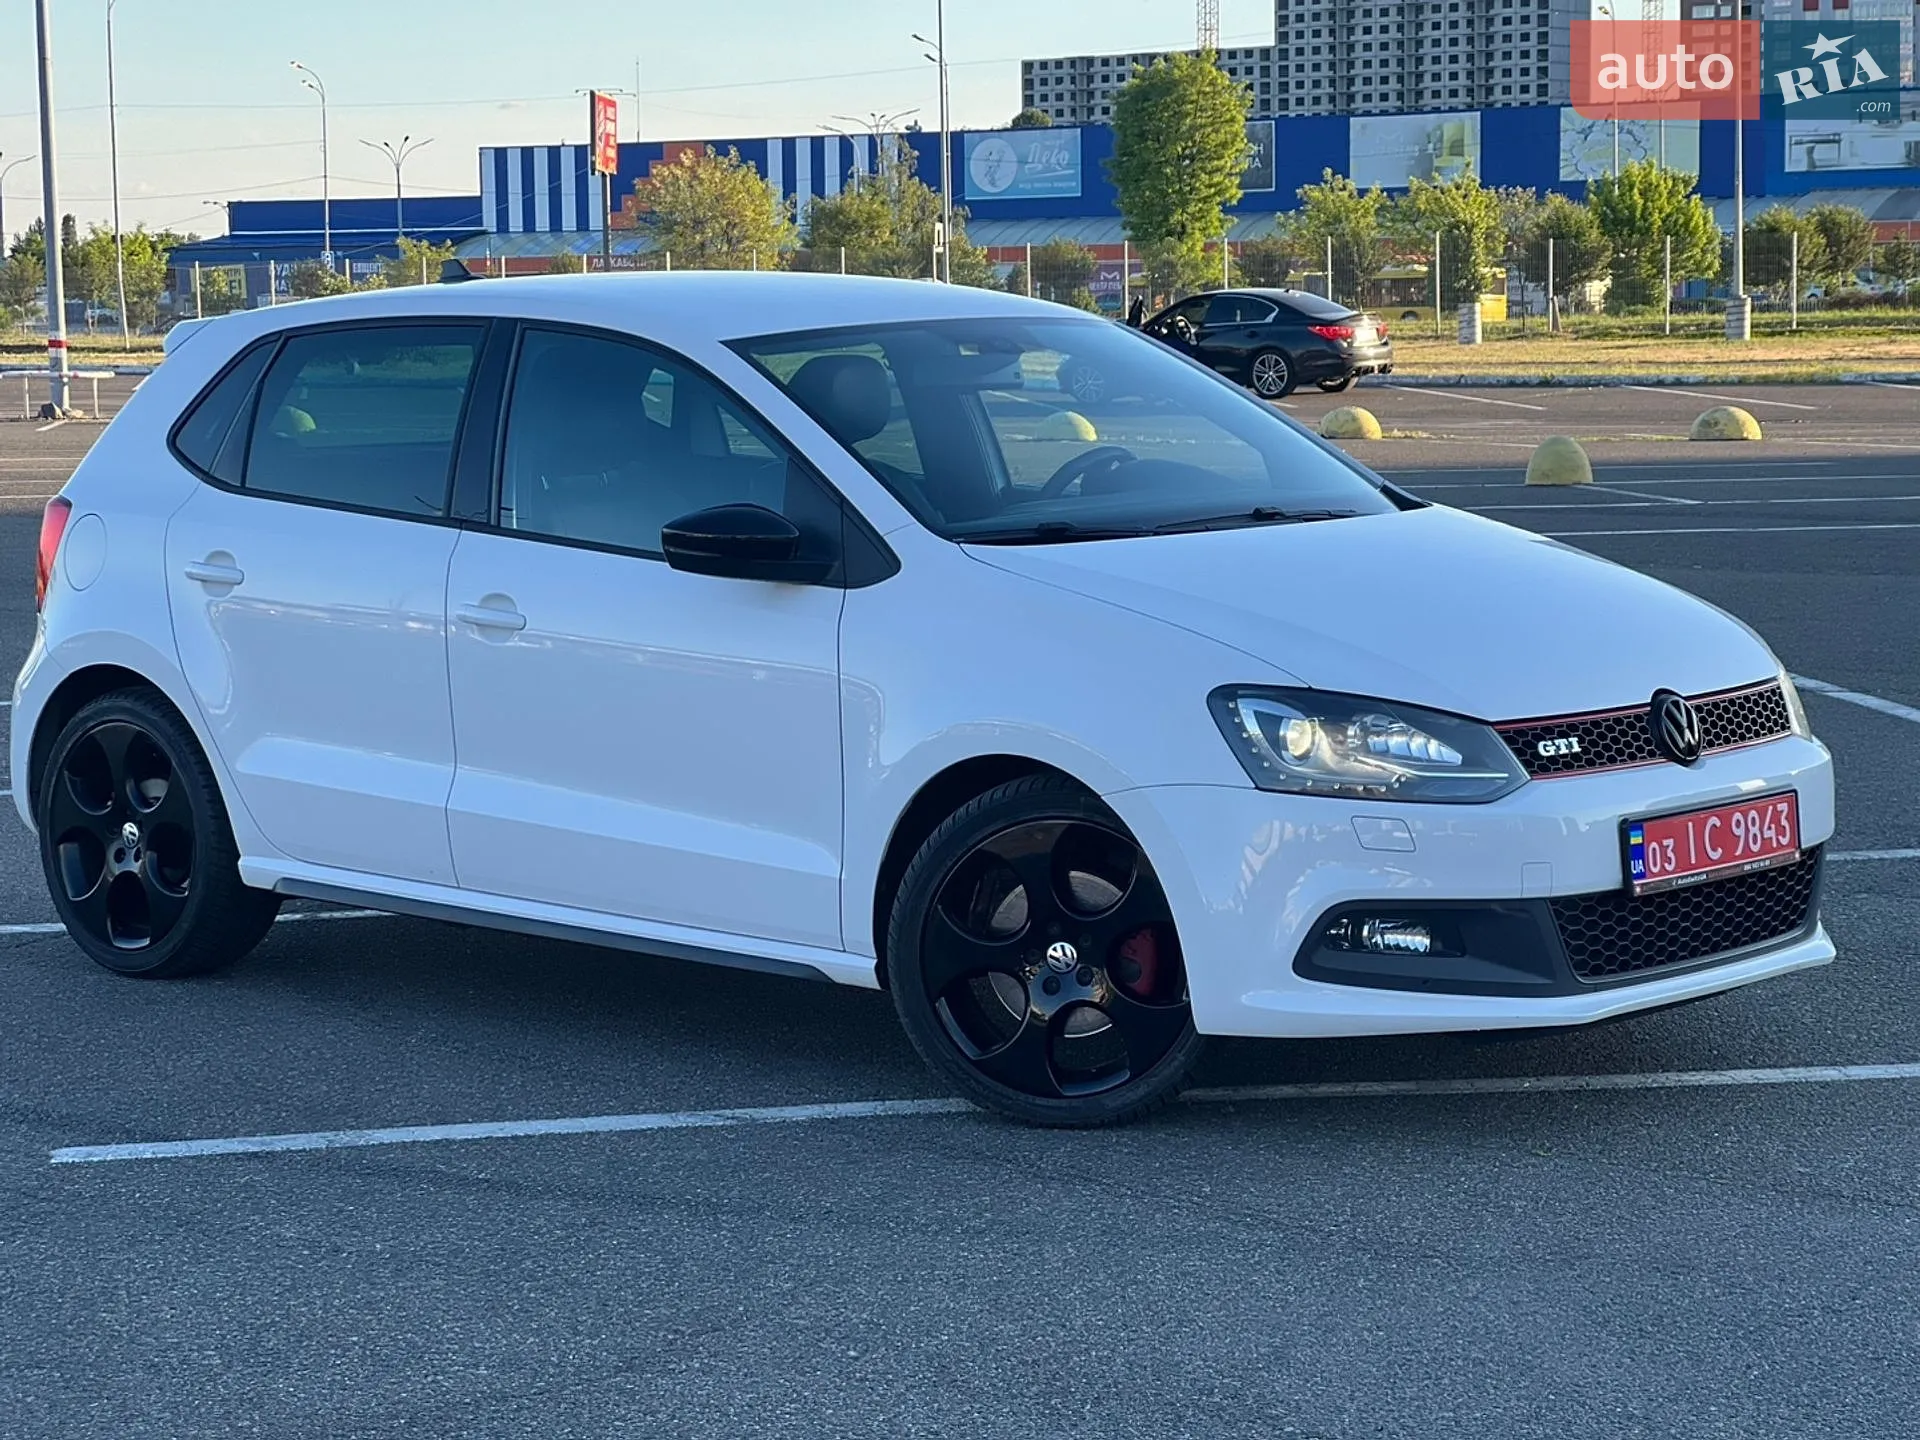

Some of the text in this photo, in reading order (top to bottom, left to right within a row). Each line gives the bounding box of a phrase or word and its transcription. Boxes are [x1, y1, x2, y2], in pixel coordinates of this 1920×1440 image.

[1538, 737, 1582, 757] GTI
[1648, 838, 1677, 874] 03
[1730, 802, 1791, 857] 9843
[1630, 859, 1646, 874] UA
